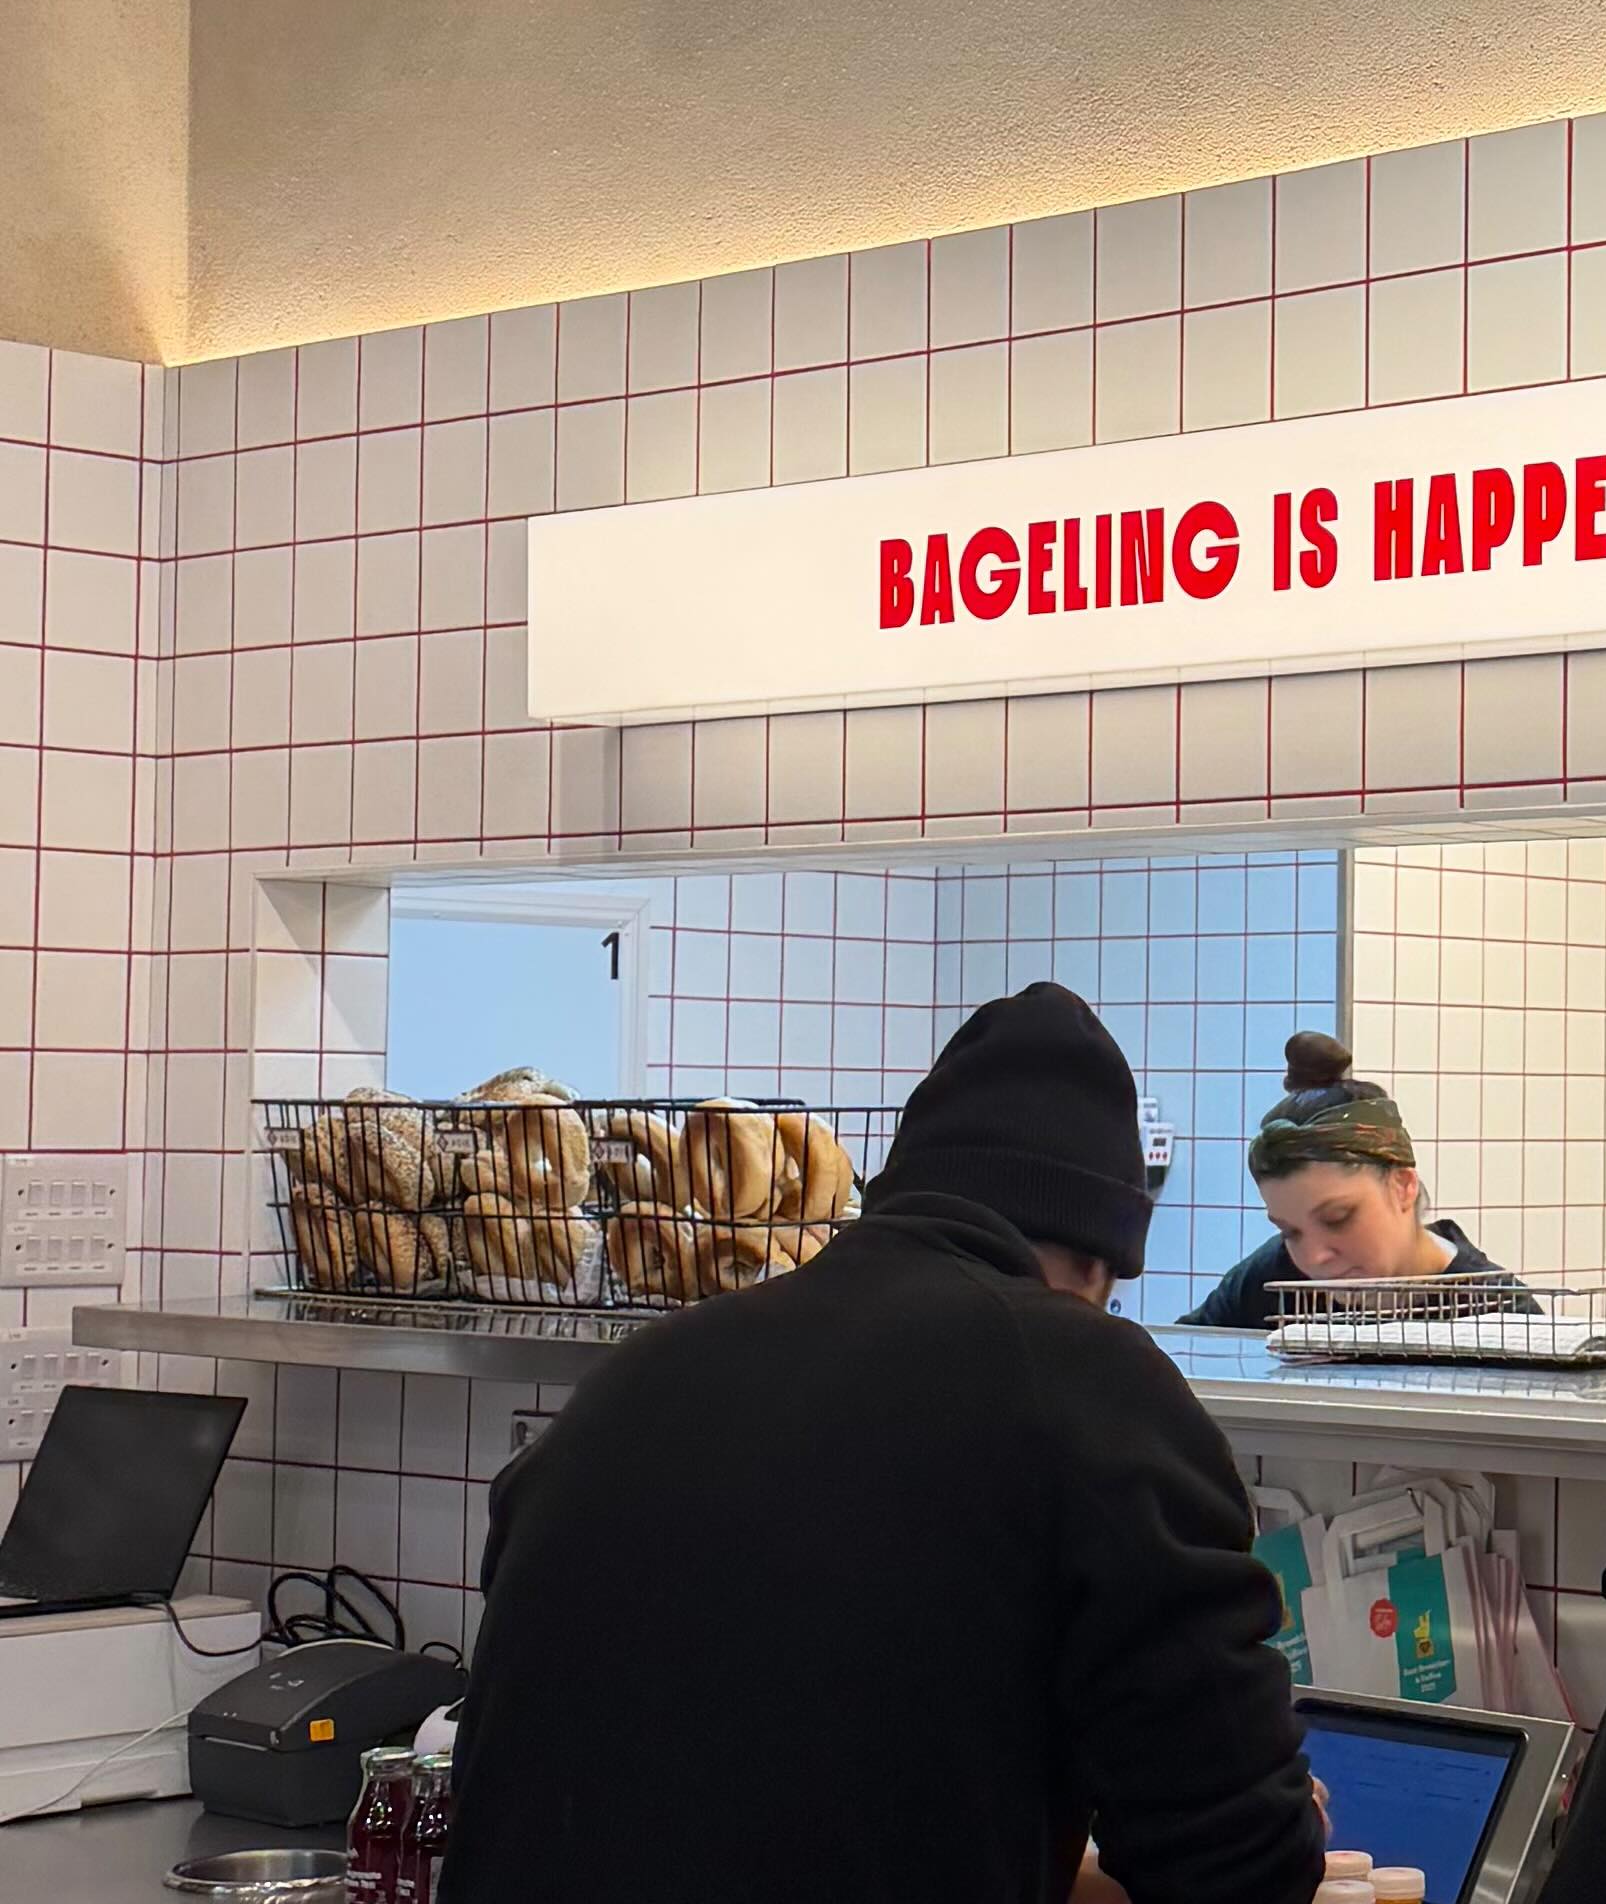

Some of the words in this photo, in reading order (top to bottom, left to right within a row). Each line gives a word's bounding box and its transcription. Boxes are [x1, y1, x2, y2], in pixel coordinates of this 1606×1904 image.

[879, 501, 1240, 629] BAGELING
[1272, 488, 1338, 591] IS
[601, 932, 619, 980] 1
